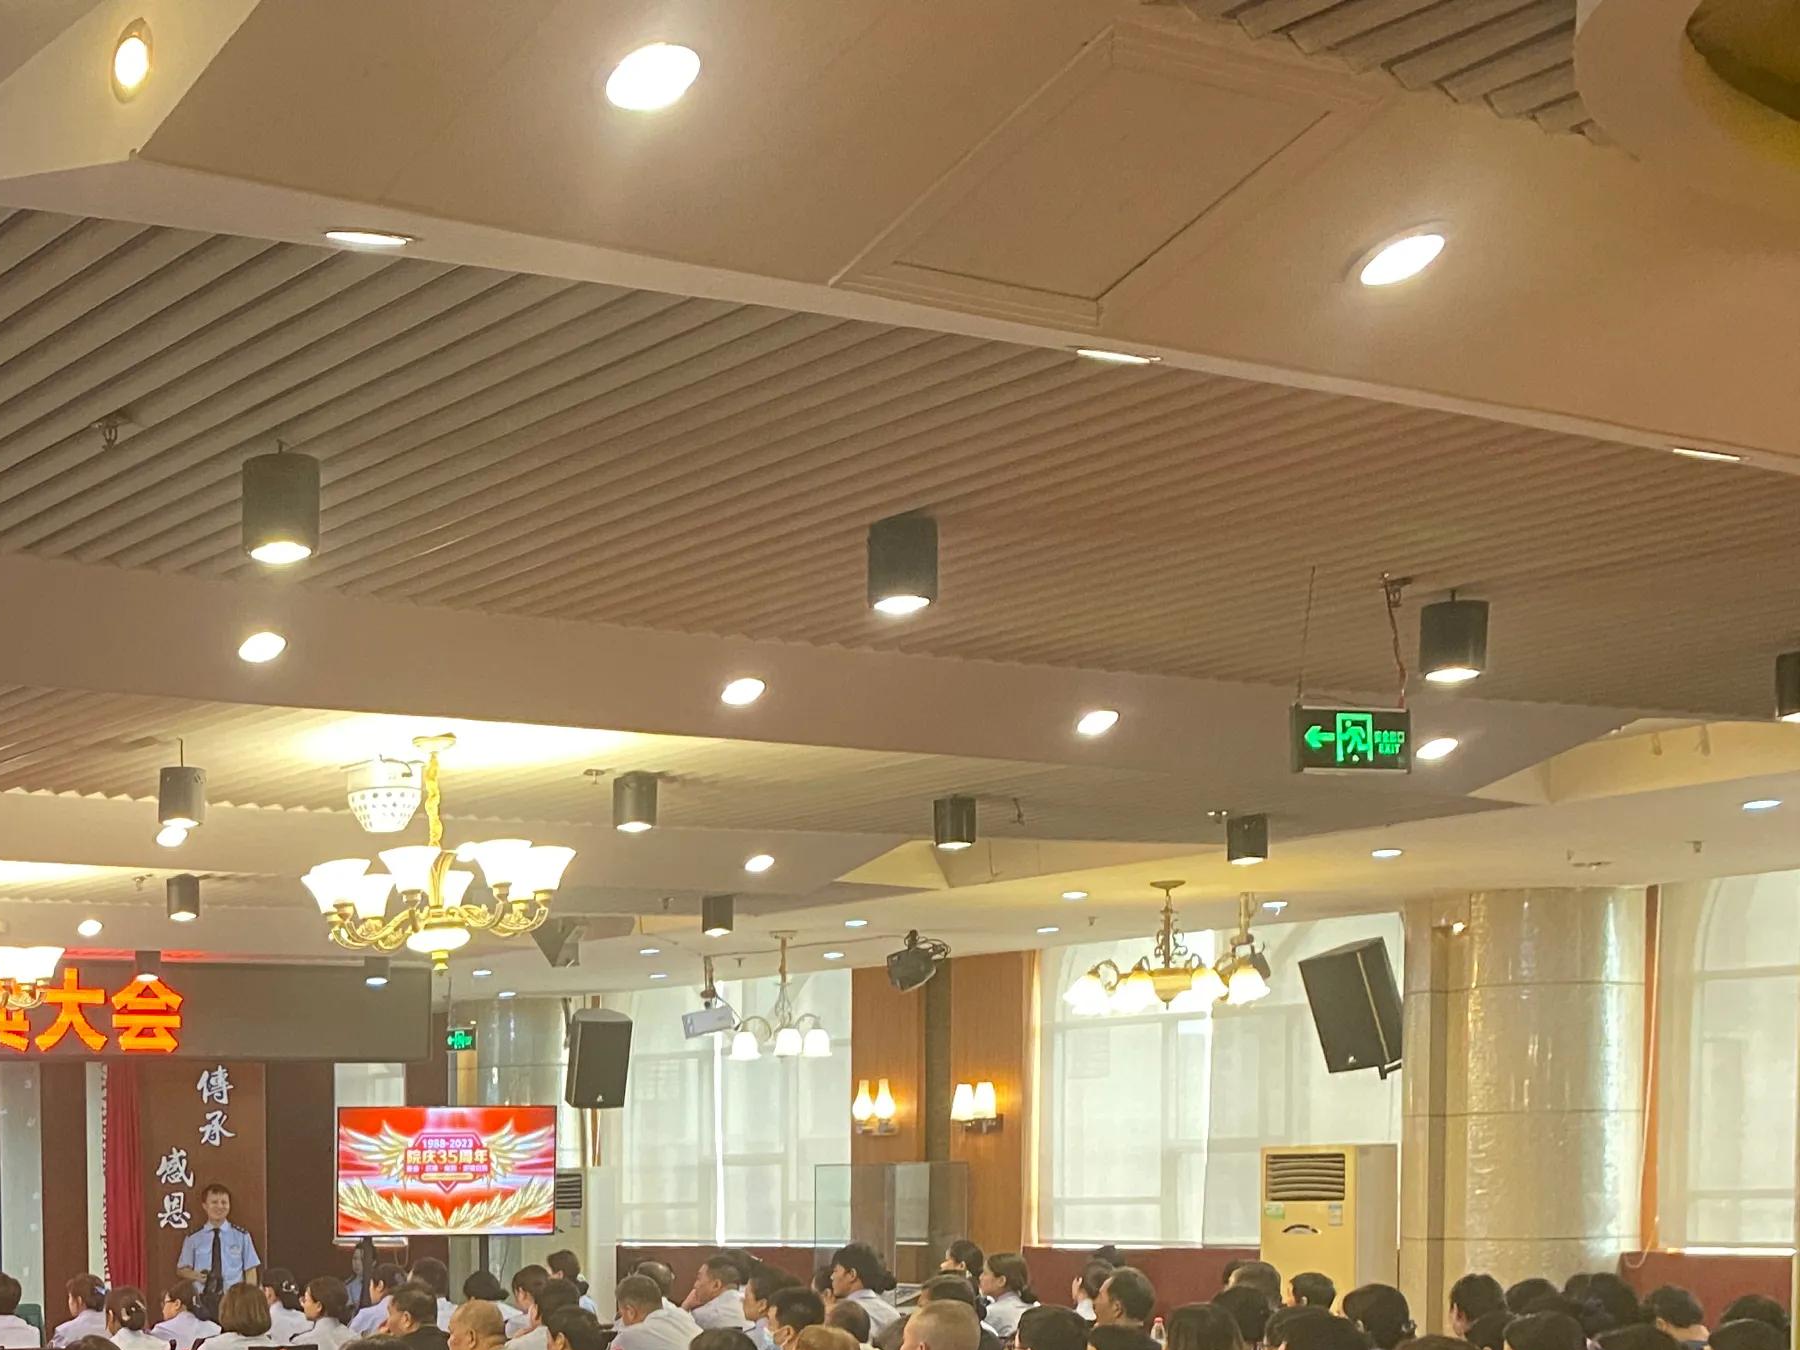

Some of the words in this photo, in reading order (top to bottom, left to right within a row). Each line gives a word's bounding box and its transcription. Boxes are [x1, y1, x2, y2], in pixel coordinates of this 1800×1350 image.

[422, 1138, 474, 1149] 1988-2023
[406, 1149, 488, 1164] 院庆35周年
